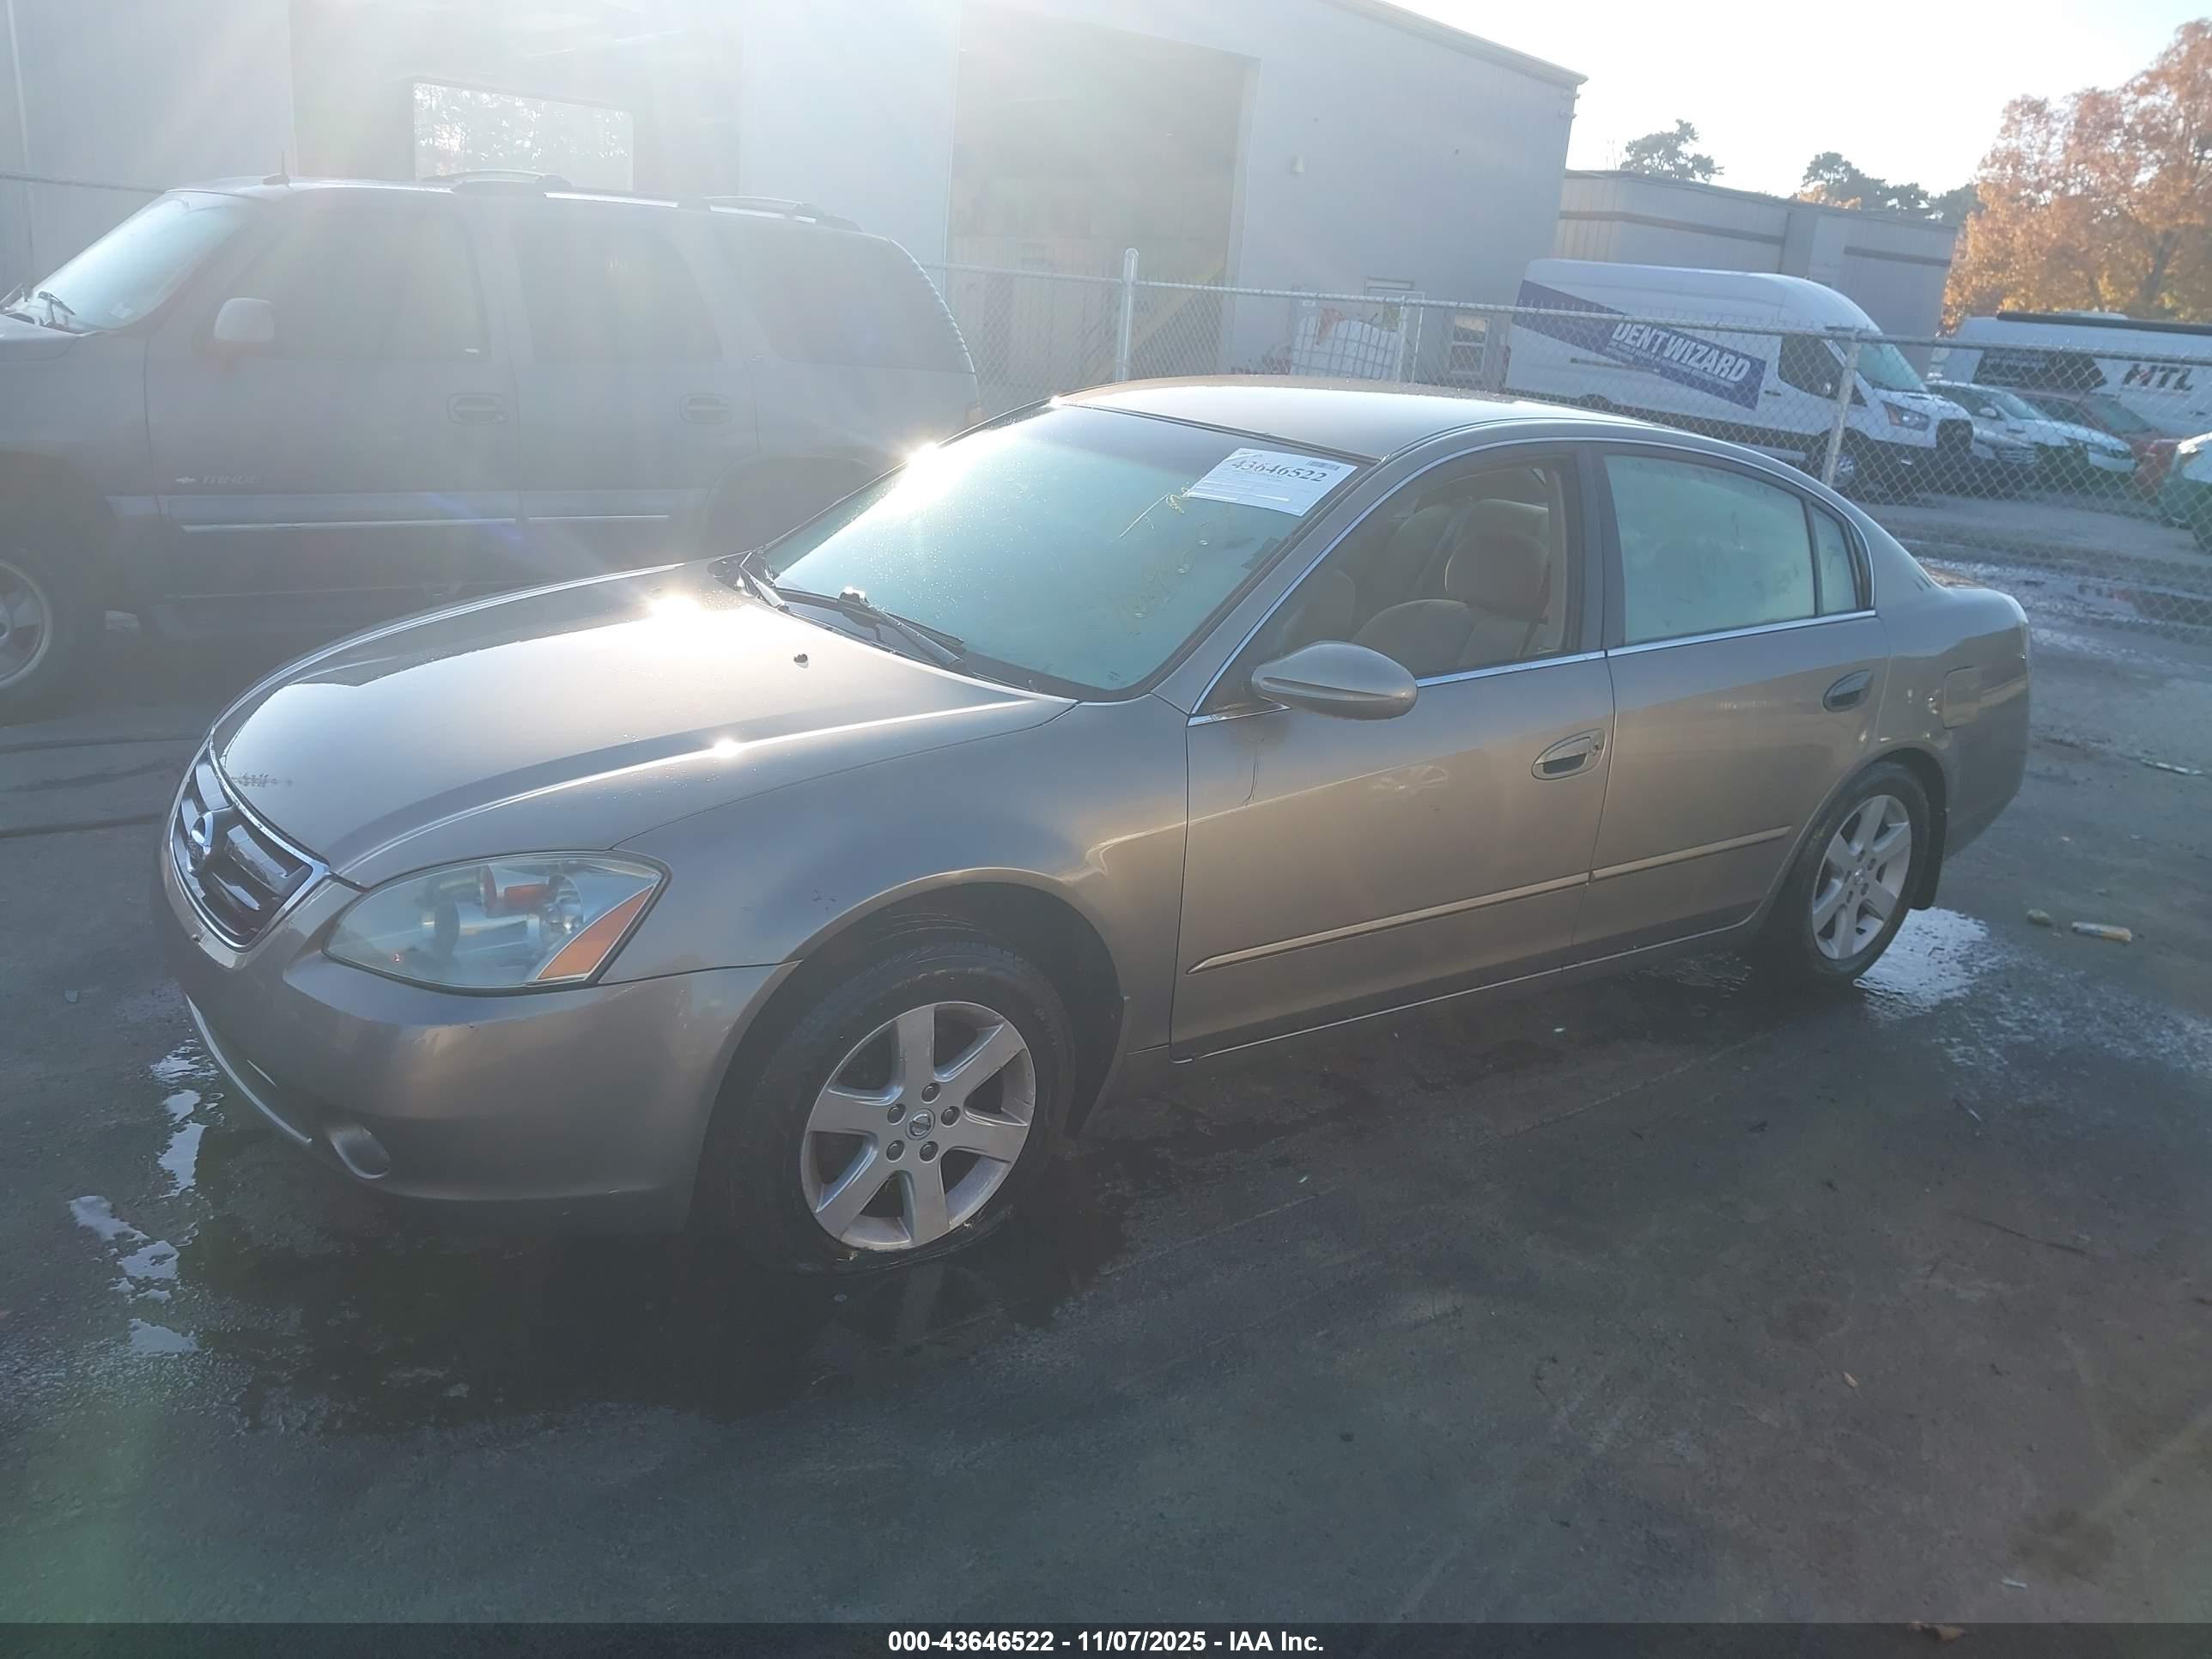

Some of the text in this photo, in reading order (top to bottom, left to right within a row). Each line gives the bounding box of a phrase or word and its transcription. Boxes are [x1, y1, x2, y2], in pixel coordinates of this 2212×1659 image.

[1611, 322, 1670, 354] DENT
[1662, 336, 1751, 382] WIZARD
[1231, 459, 1328, 482] 43646522
